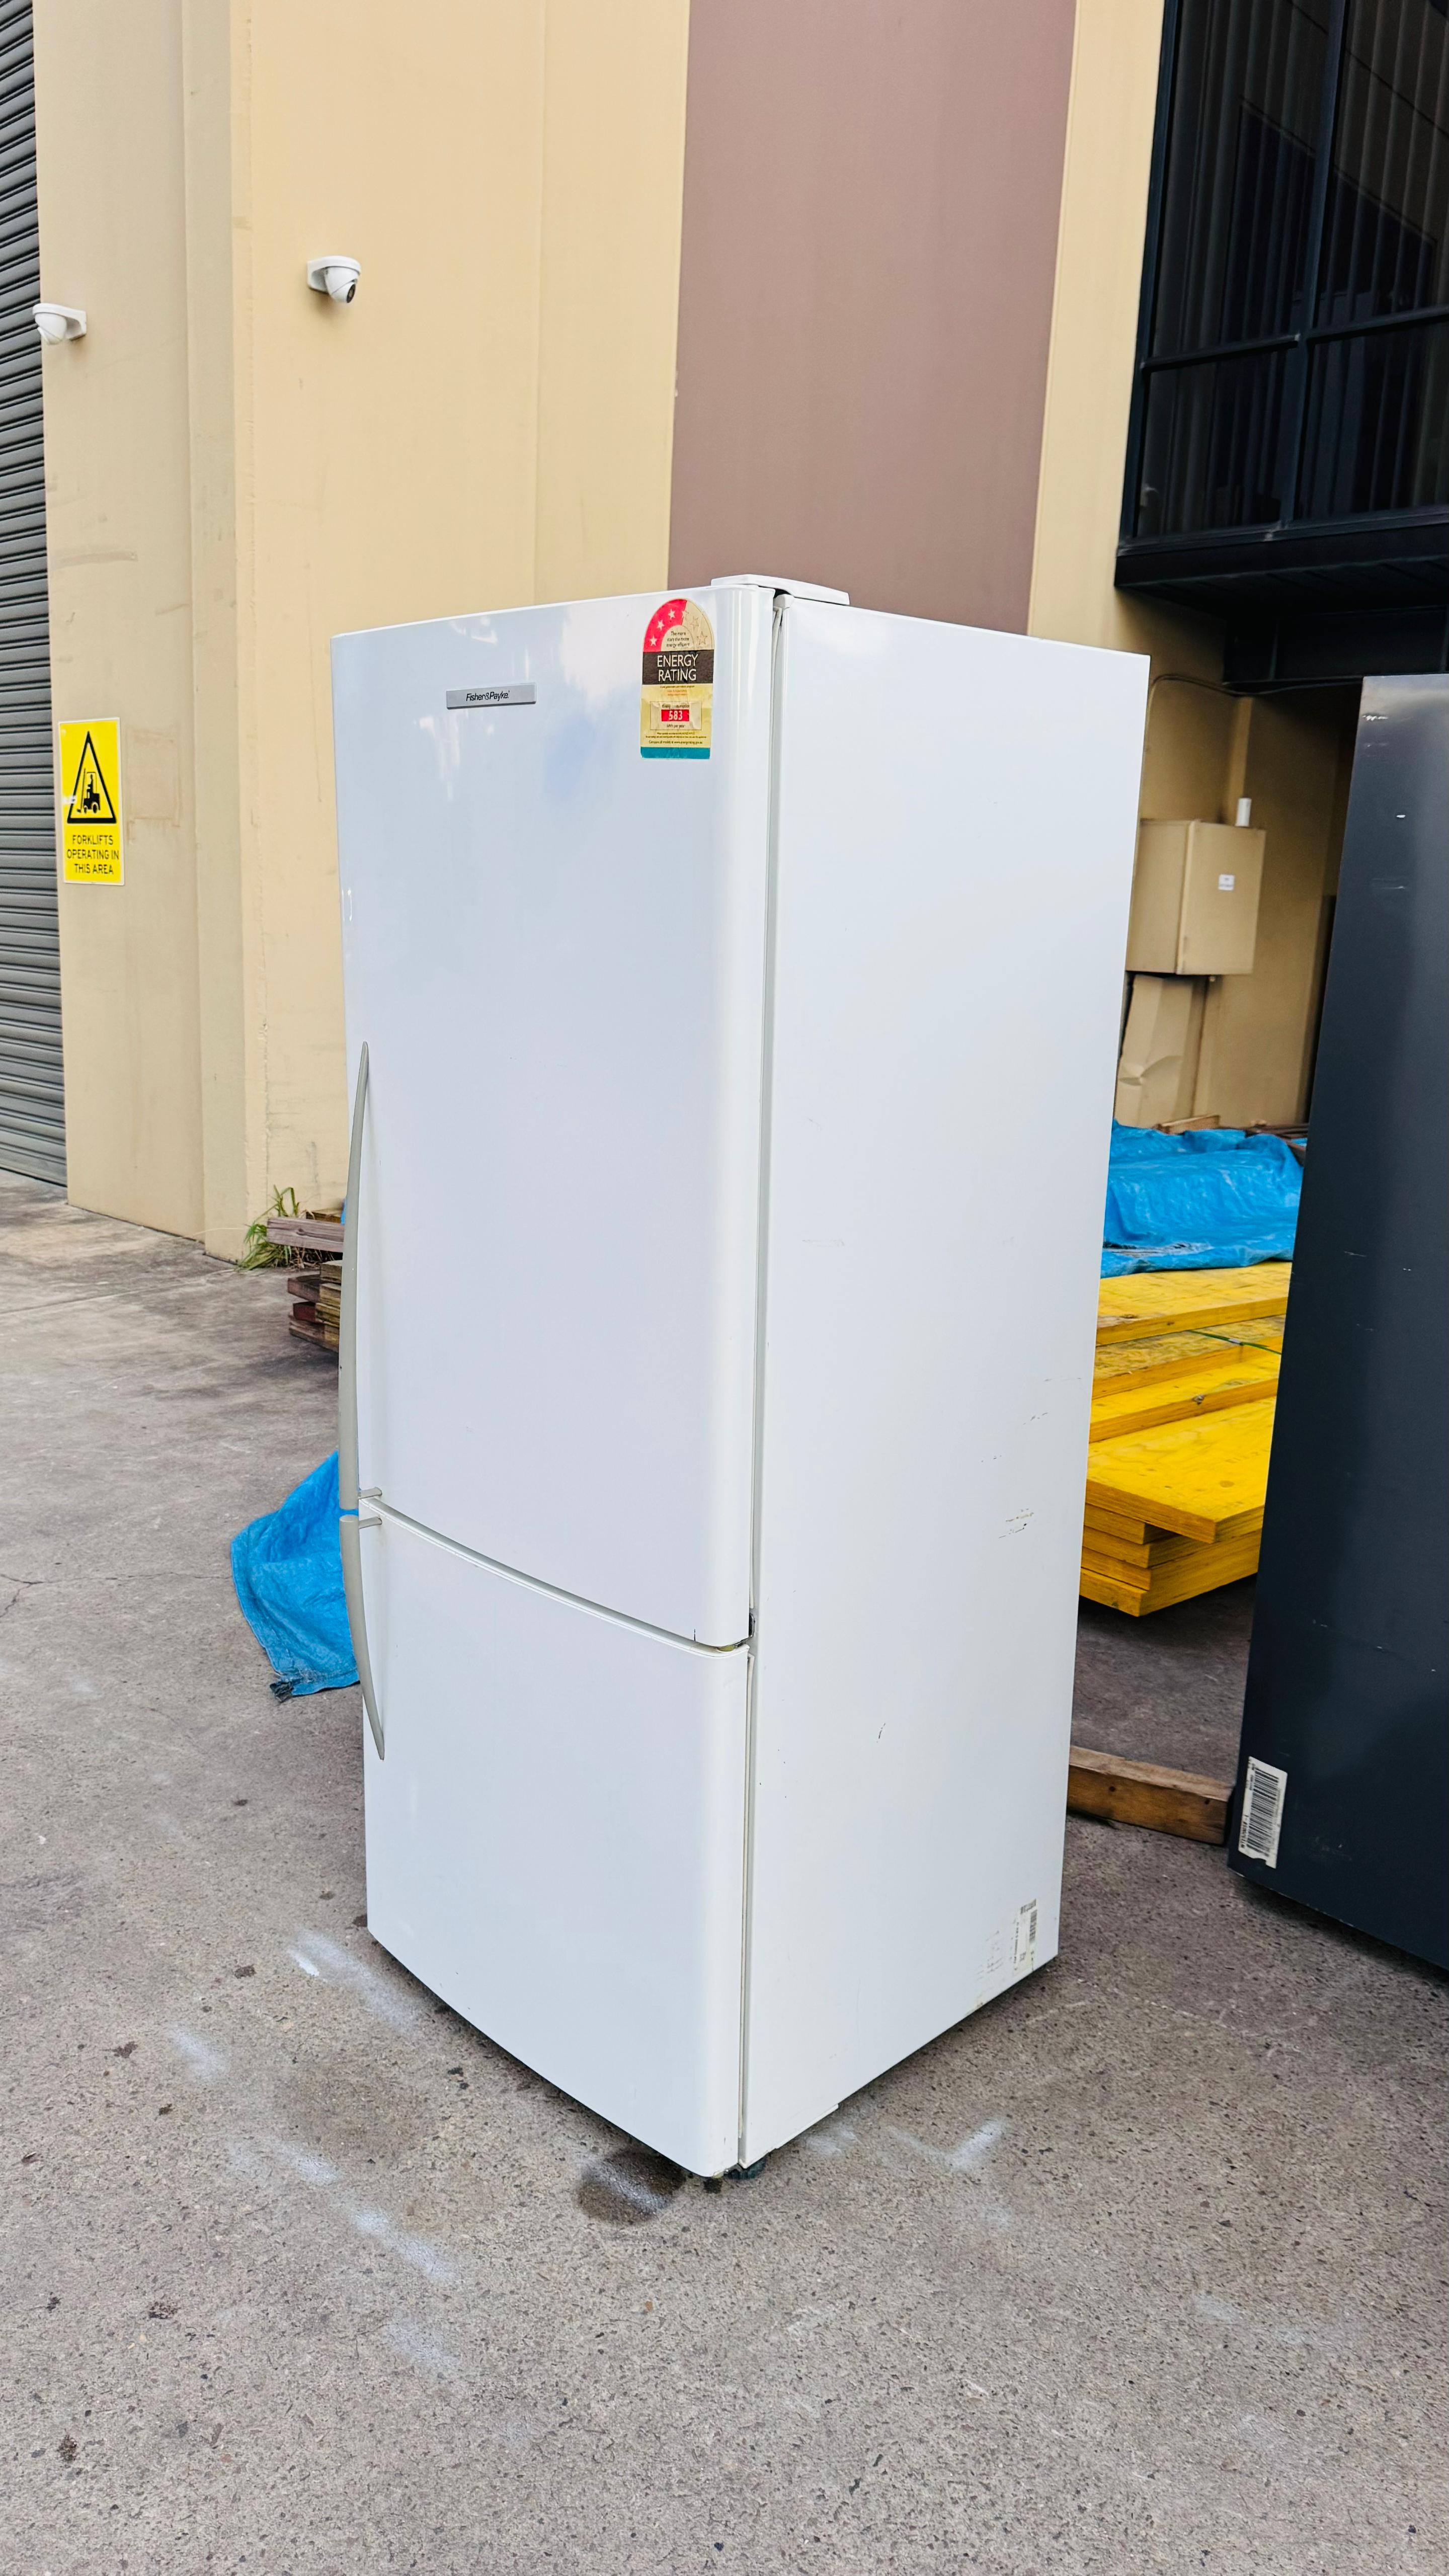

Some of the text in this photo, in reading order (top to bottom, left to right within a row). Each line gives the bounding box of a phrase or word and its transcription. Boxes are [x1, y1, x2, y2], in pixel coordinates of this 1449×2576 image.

[657, 654, 698, 667] ENERGY
[658, 668, 696, 681] RATING
[668, 710, 683, 720] 583
[72, 835, 114, 845] FORKLIFTS
[67, 849, 119, 860] OPERATING IN
[74, 863, 114, 874] THIS AREA
